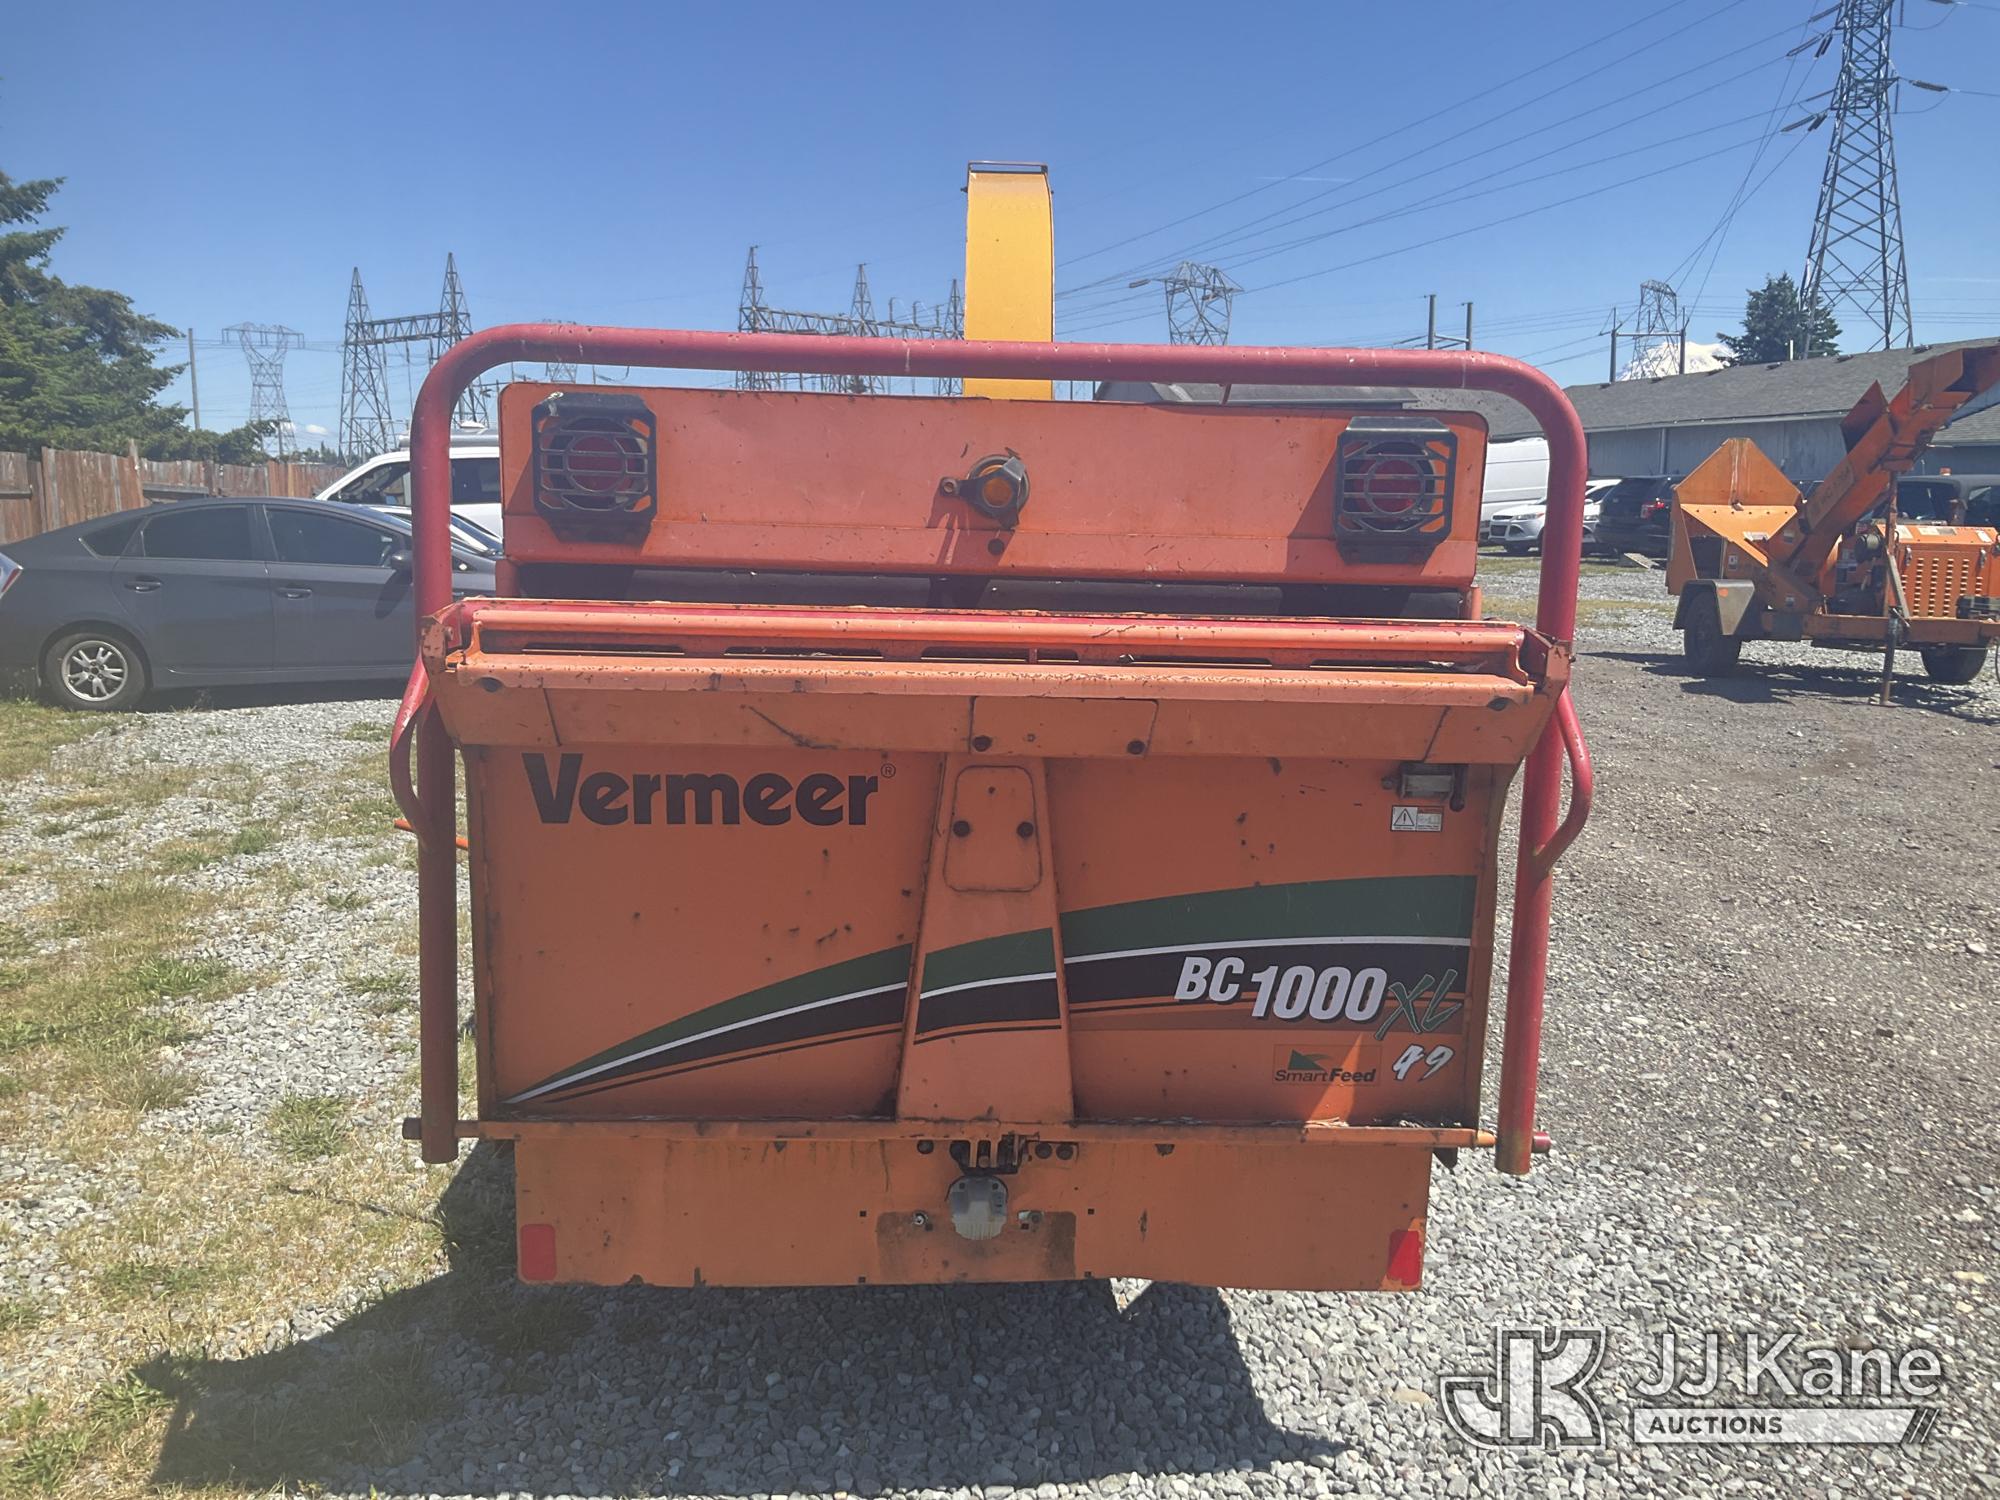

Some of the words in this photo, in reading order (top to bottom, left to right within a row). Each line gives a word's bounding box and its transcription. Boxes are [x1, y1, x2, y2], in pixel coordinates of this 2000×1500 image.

[1174, 956, 1246, 1002] BC
[1250, 965, 1388, 1022] 1000
[1374, 968, 1463, 1040] XL
[1274, 1067, 1377, 1083] SmartFeed
